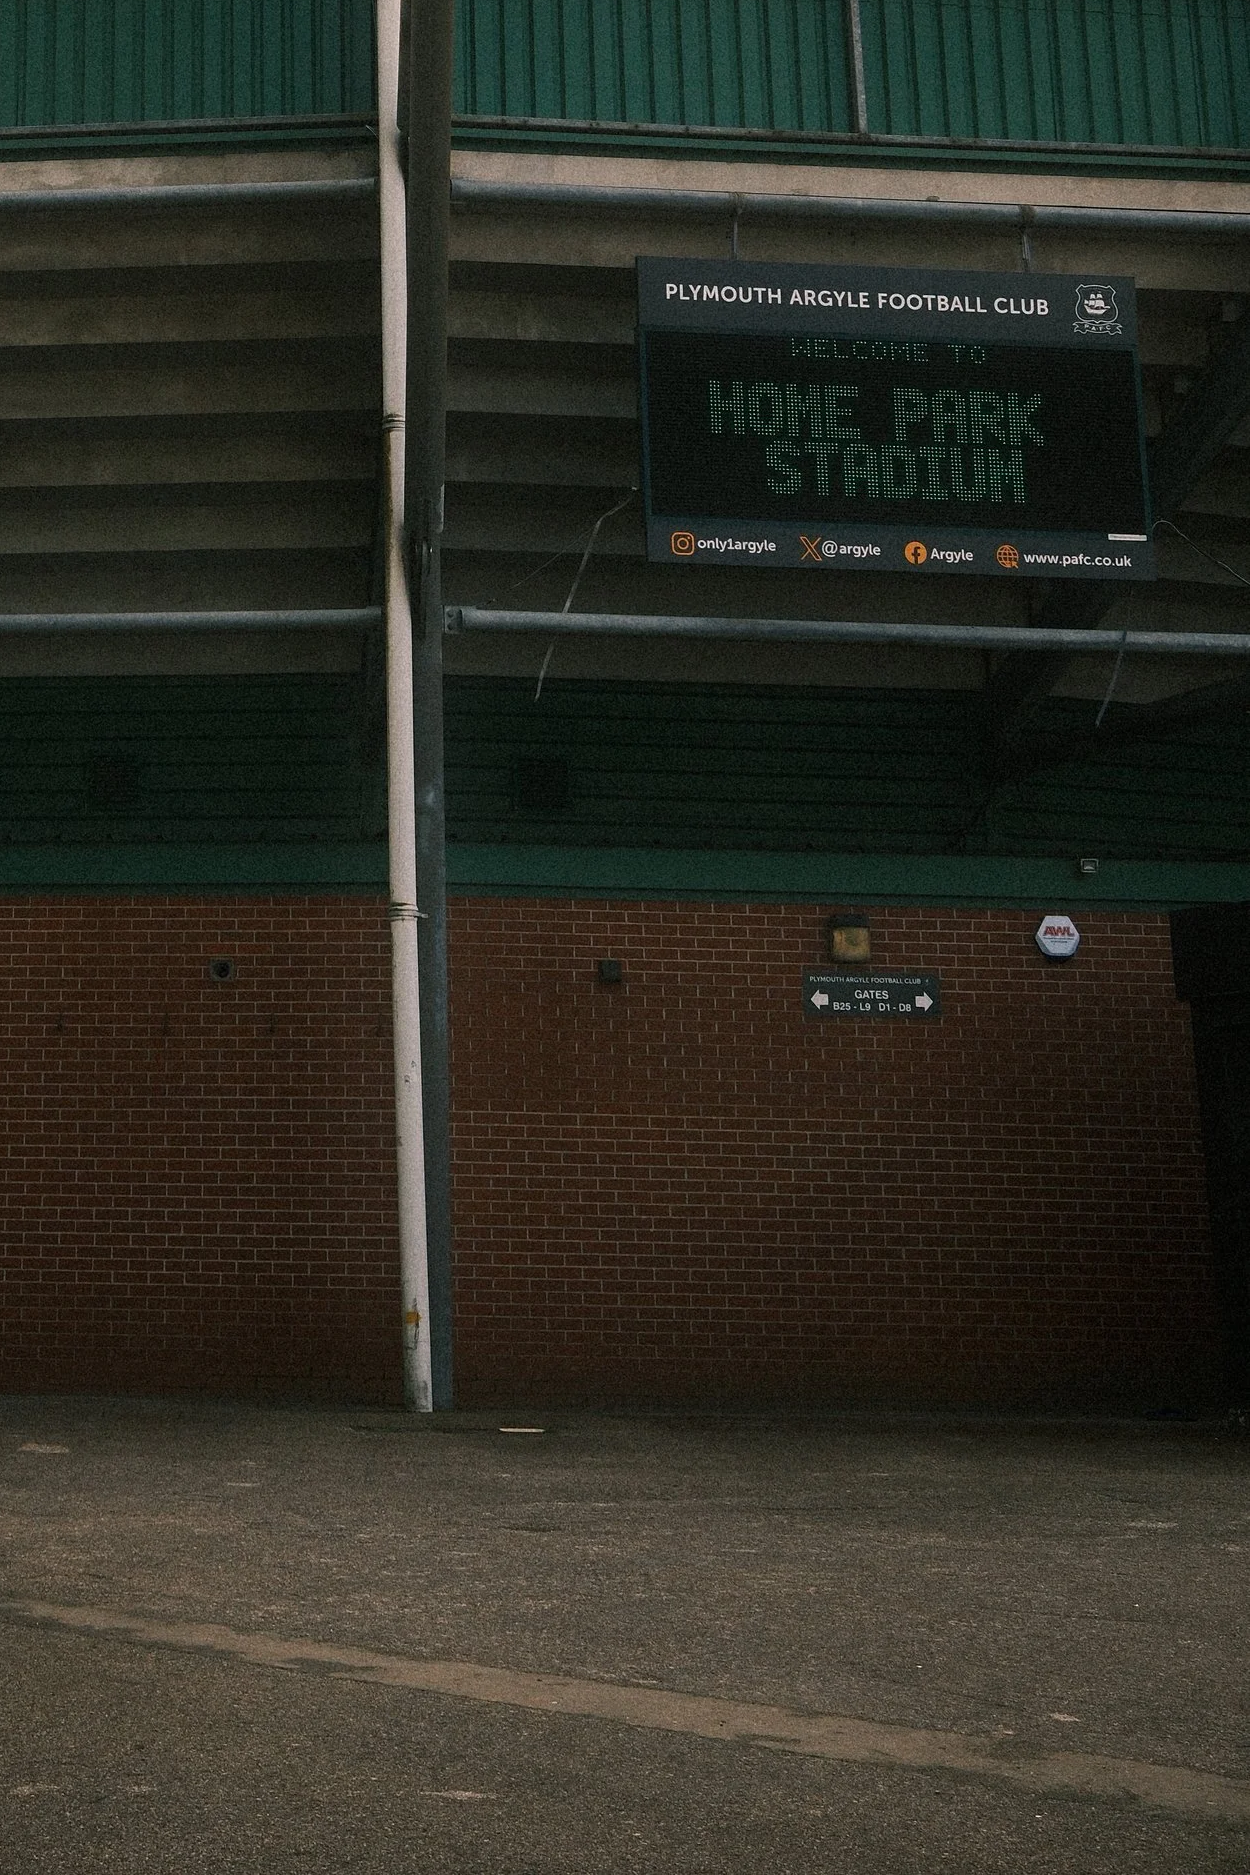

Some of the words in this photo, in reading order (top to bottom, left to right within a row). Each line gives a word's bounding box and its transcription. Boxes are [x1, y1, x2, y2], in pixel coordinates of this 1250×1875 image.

[665, 283, 782, 305] PLYMOUTH
[789, 289, 871, 309] ARGYLE
[877, 292, 988, 314] FOOTBALL
[993, 297, 1050, 316] CLUB
[791, 337, 929, 363] WELCOME
[947, 343, 986, 364] TO
[708, 379, 862, 440] HOME
[892, 387, 1045, 447] PARK
[765, 440, 1027, 503] STADIUM
[697, 536, 777, 554] only1argyle
[821, 540, 882, 558] @argyle
[930, 547, 974, 564] Argyle
[1023, 552, 1133, 568] www.pafc.co.uk
[845, 976, 870, 984] ARGYLE
[904, 977, 922, 985] CLUB
[854, 990, 890, 1000] GATES
[833, 1001, 851, 1011] B25
[859, 1002, 871, 1011] L9
[878, 1003, 890, 1012] D1
[898, 1003, 912, 1012] D8
